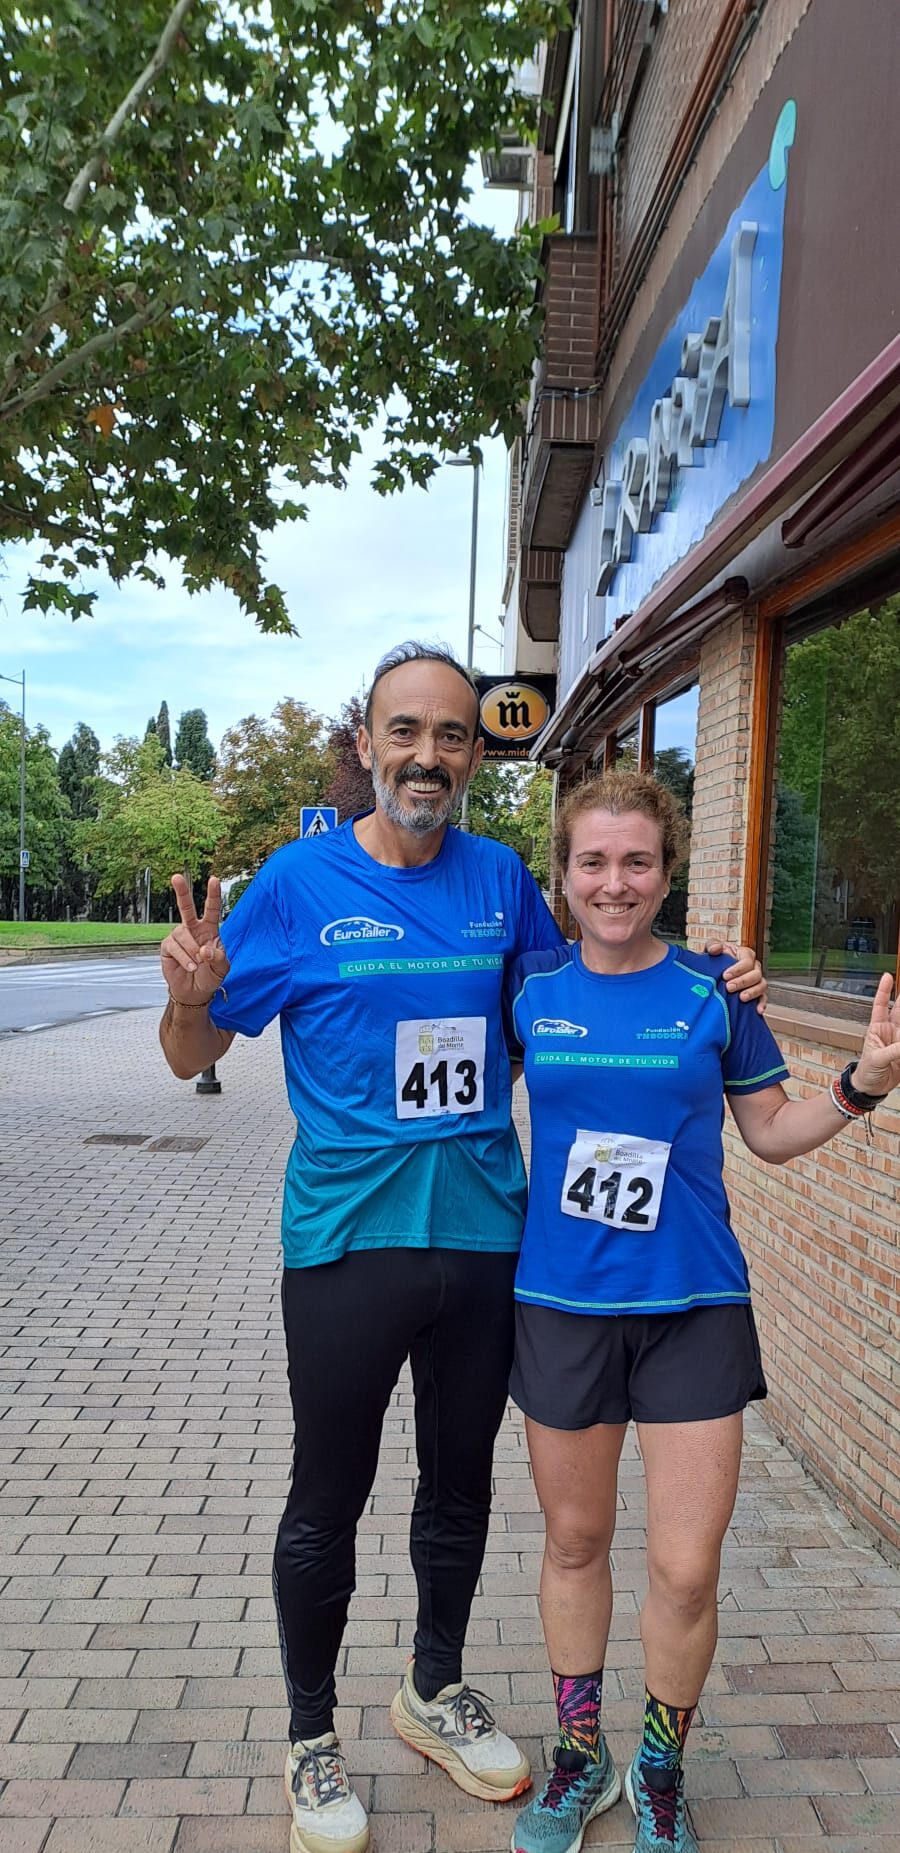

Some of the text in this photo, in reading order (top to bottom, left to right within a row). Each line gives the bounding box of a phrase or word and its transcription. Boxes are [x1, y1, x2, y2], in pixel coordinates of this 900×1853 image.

[333, 926, 391, 941] EuroTaller
[347, 963, 385, 973] CUIDA
[390, 962, 402, 970] EL
[407, 961, 448, 970] MOTOR
[453, 960, 468, 968] DE
[471, 958, 484, 966] TU
[402, 1059, 478, 1110] 413
[566, 1166, 653, 1225] 412
